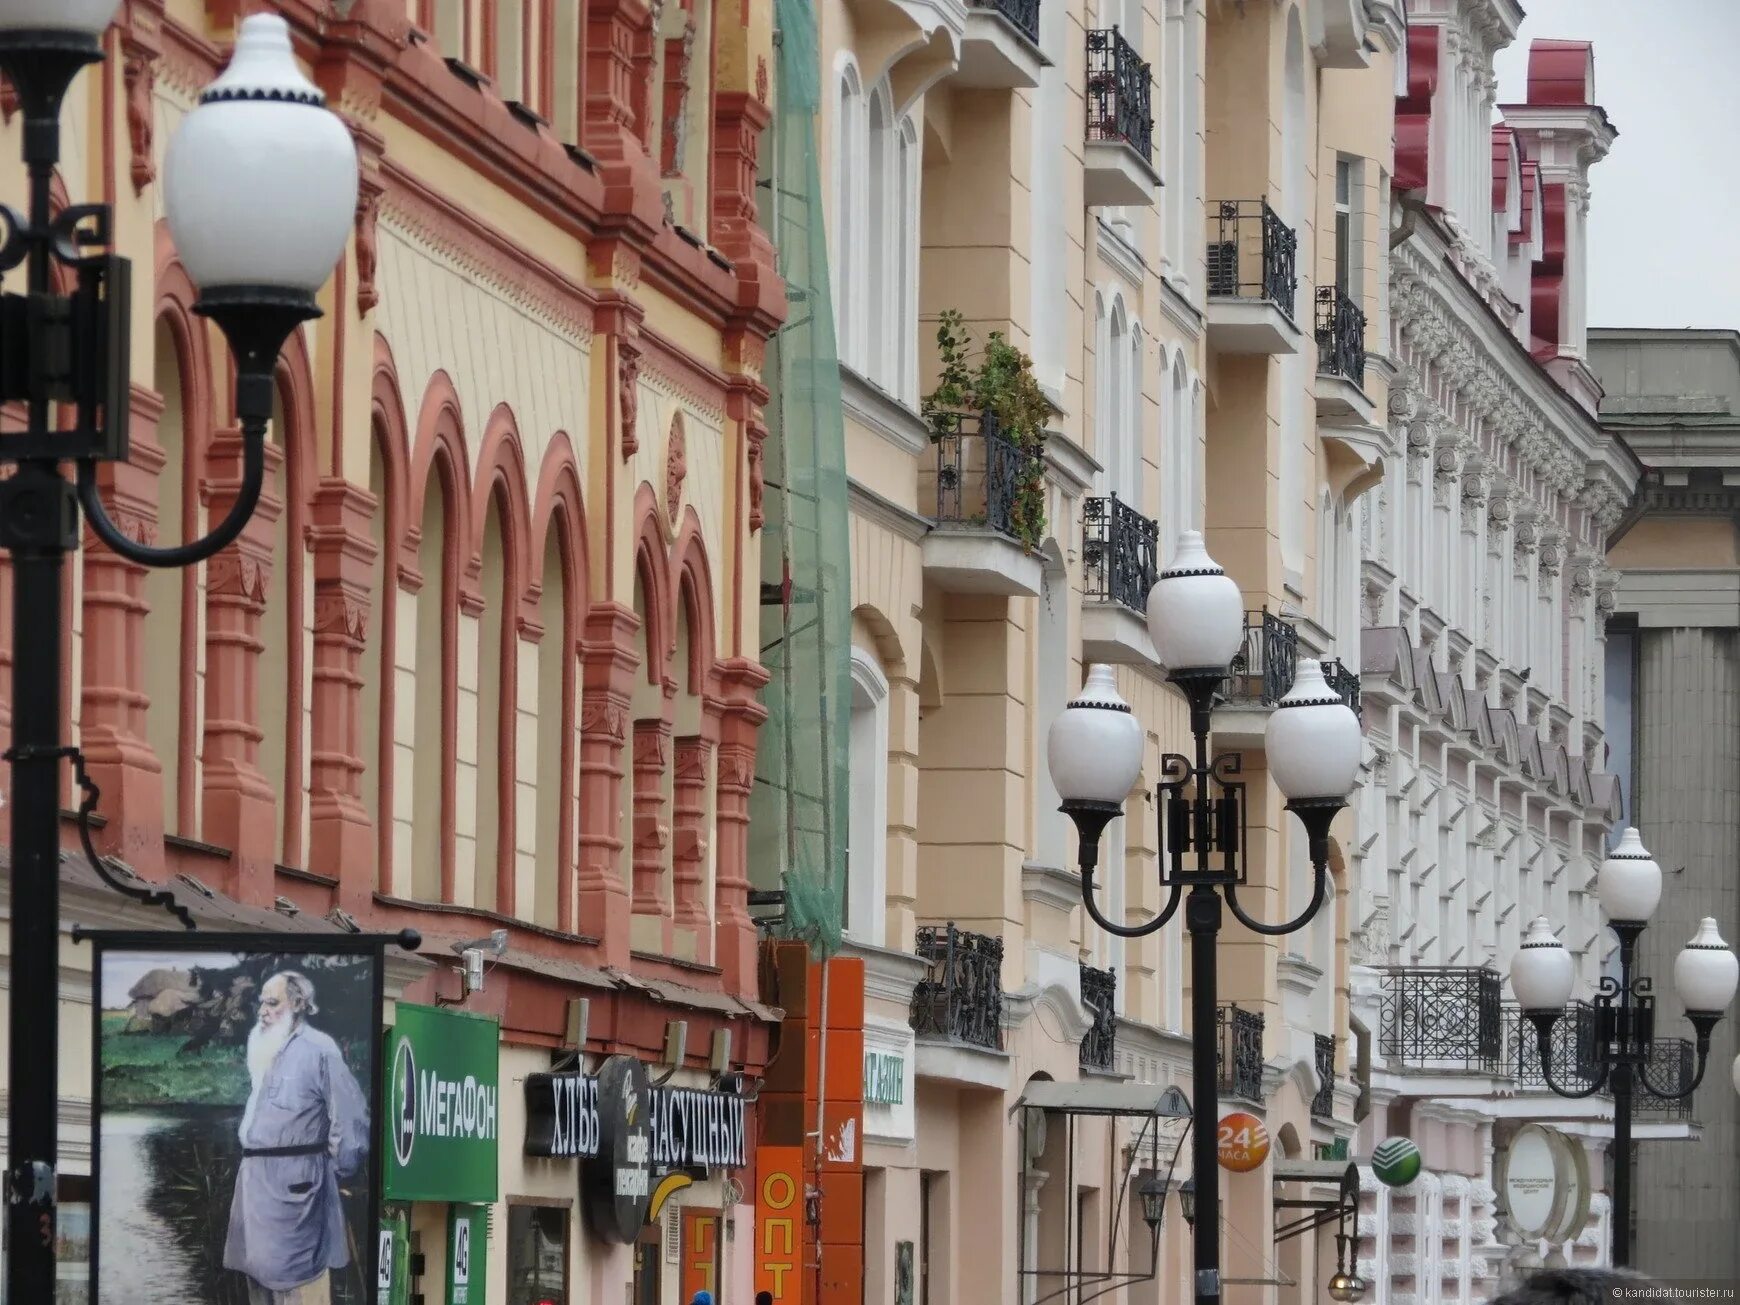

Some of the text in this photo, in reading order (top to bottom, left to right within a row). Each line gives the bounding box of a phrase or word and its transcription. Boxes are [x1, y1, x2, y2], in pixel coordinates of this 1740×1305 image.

[647, 1077, 747, 1176] НАСУЩНЫЙ
[1217, 1126, 1249, 1149] 24
[380, 1237, 391, 1282] 4G
[456, 1226, 468, 1276] 4G
